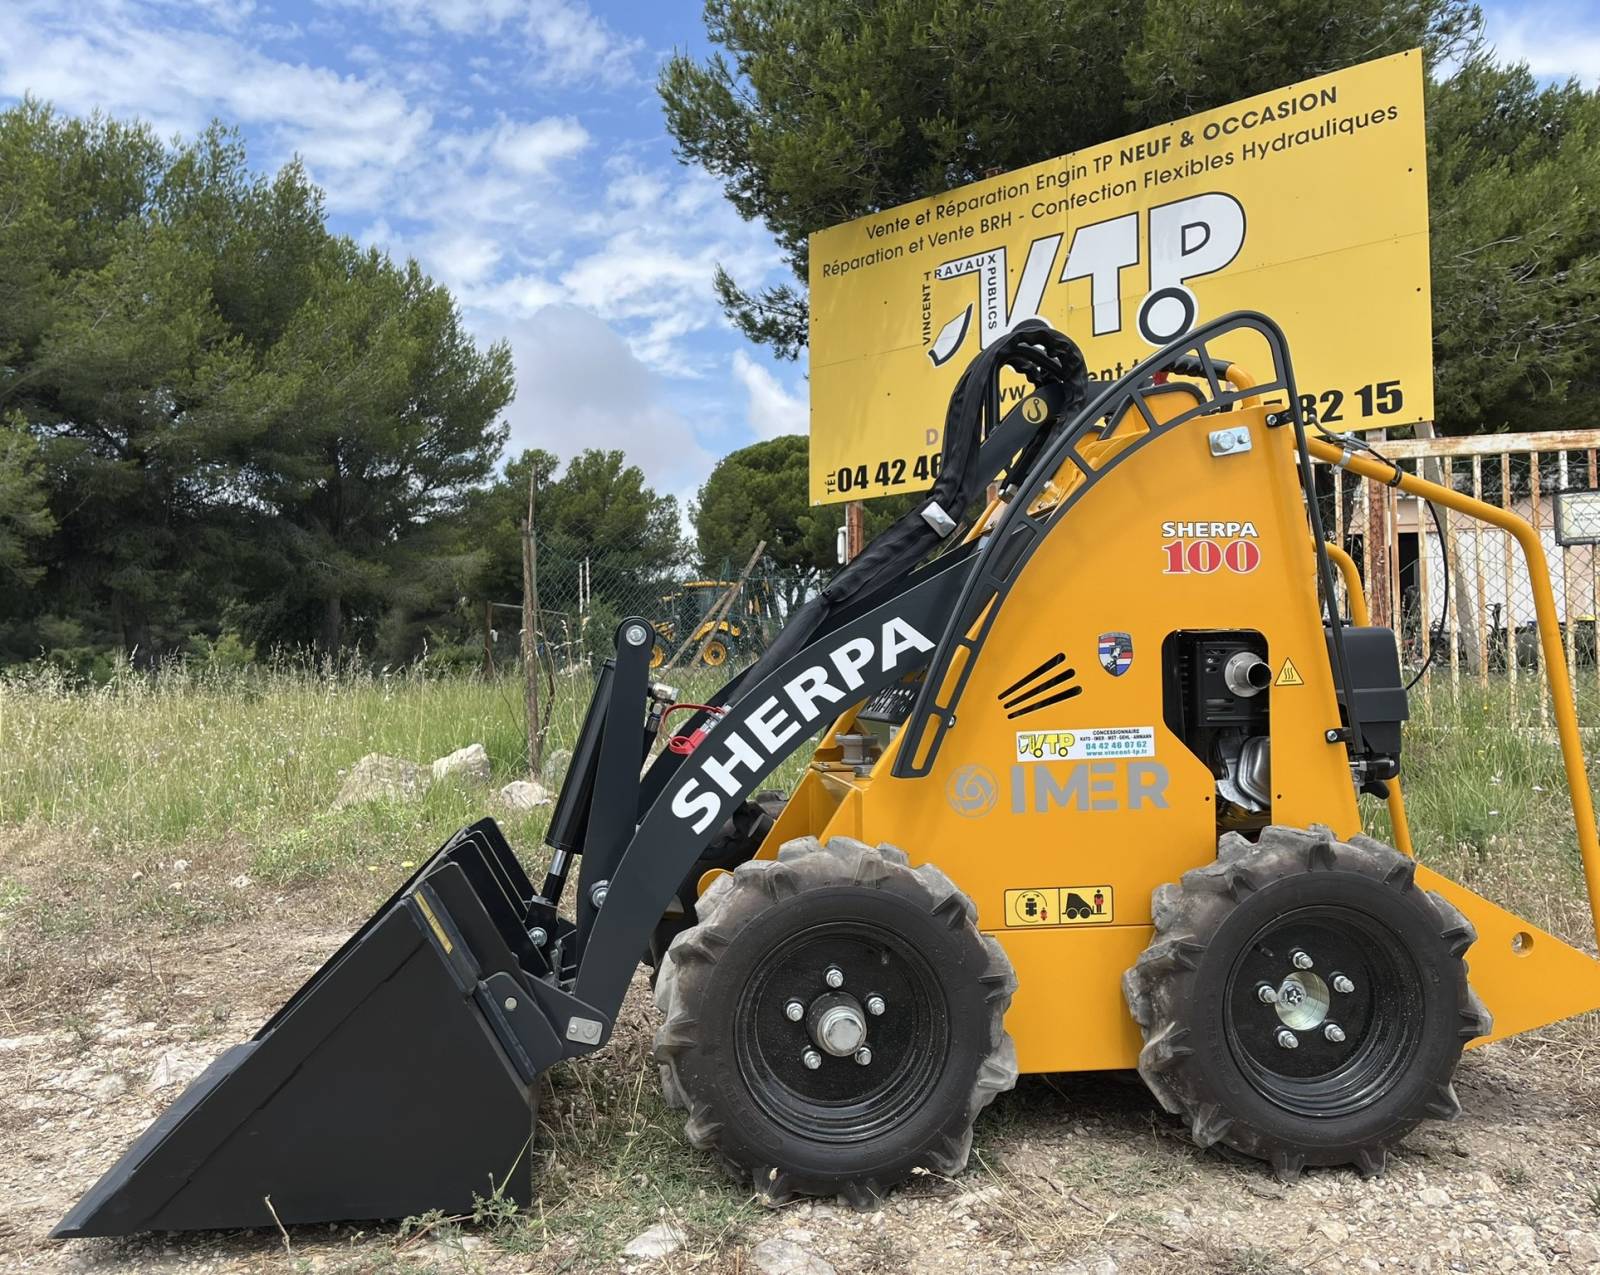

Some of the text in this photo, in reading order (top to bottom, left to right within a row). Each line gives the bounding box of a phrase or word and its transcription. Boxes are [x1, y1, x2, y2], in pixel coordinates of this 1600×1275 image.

[865, 86, 1337, 240] Vente et Réparation Engin TP NEUF & OCCASION
[822, 244, 904, 278] Réparation
[908, 236, 924, 254] et
[927, 223, 975, 248] Vente
[979, 211, 1012, 235] BRH
[1031, 179, 1137, 220] Confection
[1143, 151, 1235, 189] Flexibles
[1241, 105, 1399, 161] Hydrauliques
[922, 253, 998, 346] VINCENT TRAVAUX PUBLICS
[1298, 379, 1404, 426] 82 15
[824, 452, 943, 495] TÉL 04 42 46
[1160, 521, 1259, 539] SHERPA
[1161, 538, 1261, 575] 100
[671, 616, 937, 836] SHERPA
[1018, 732, 1076, 759] VTP
[1085, 743, 1097, 751] 04
[1099, 742, 1109, 750] 42
[1124, 741, 1135, 749] 07
[1136, 740, 1147, 748] 62
[1092, 728, 1140, 736] CONCESSIONNAIRE
[1009, 761, 1171, 814] IMER
